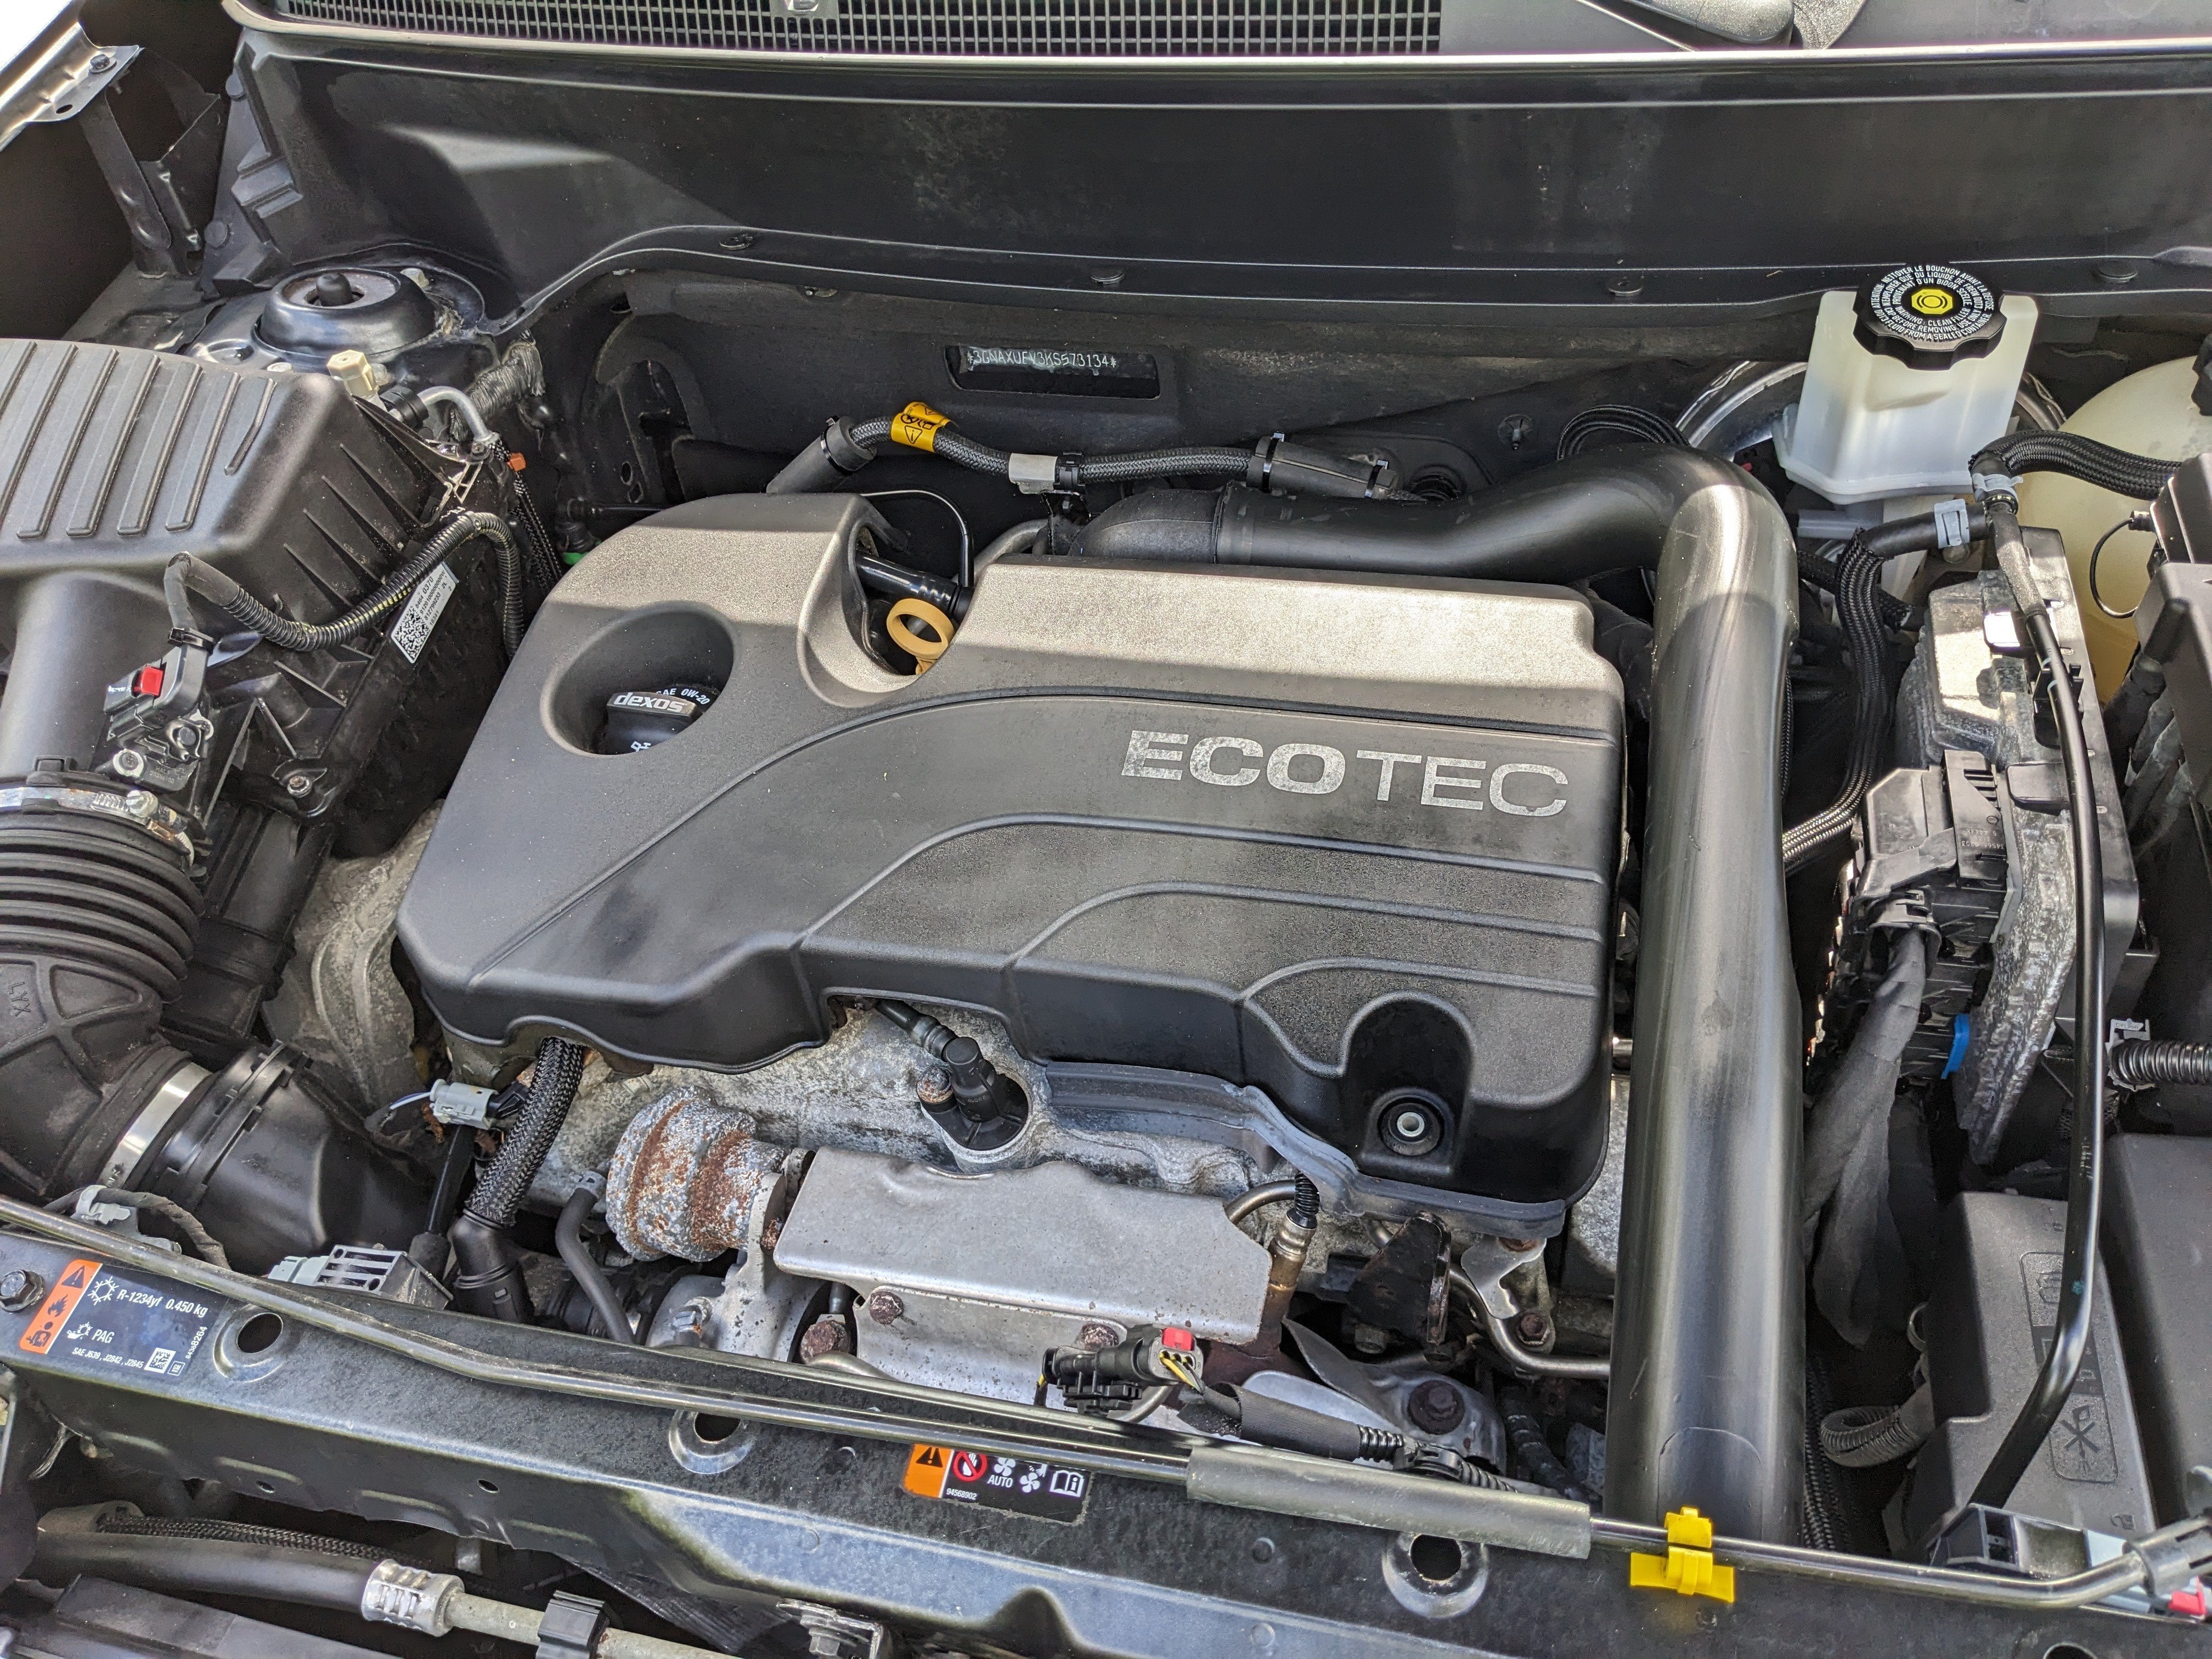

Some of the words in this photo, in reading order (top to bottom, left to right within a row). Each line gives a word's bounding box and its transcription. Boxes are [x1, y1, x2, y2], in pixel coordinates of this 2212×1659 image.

[1881, 267, 1914, 283] NETTOYER
[1926, 265, 1960, 276] BOUCHON
[1959, 273, 1982, 285] AVANT
[1892, 280, 1916, 304] PROVENANT
[1937, 278, 1959, 290] BIDON
[1899, 274, 1914, 283] QUE
[1927, 272, 1955, 281] LIQUIDE
[1963, 283, 1980, 296] FREIN
[1973, 297, 1983, 308] DOT3
[1874, 309, 1889, 321] DOT3
[1885, 319, 1905, 332] FLUID
[1904, 329, 1926, 339] FROM
[1933, 331, 1962, 340] SEALED
[1884, 307, 1896, 316] CAP
[1892, 315, 1918, 330] BEFORE
[1957, 319, 1972, 329] USE
[1967, 309, 1982, 321] ONLY
[1950, 308, 1971, 323] FILLER
[422, 576, 433, 594] 0370
[613, 692, 685, 712] dexos
[681, 688, 710, 705] 0W-20
[1121, 730, 1567, 816] ECOTEC
[116, 1288, 163, 1308] R-1234yf
[166, 1298, 193, 1313] 0.450
[193, 1304, 208, 1318] kg
[92, 1329, 115, 1344] PAG
[72, 1347, 85, 1356] SAE
[125, 1359, 144, 1368] J2845
[988, 1475, 1013, 1488] AUTO
[946, 1488, 978, 1500] 94568902
